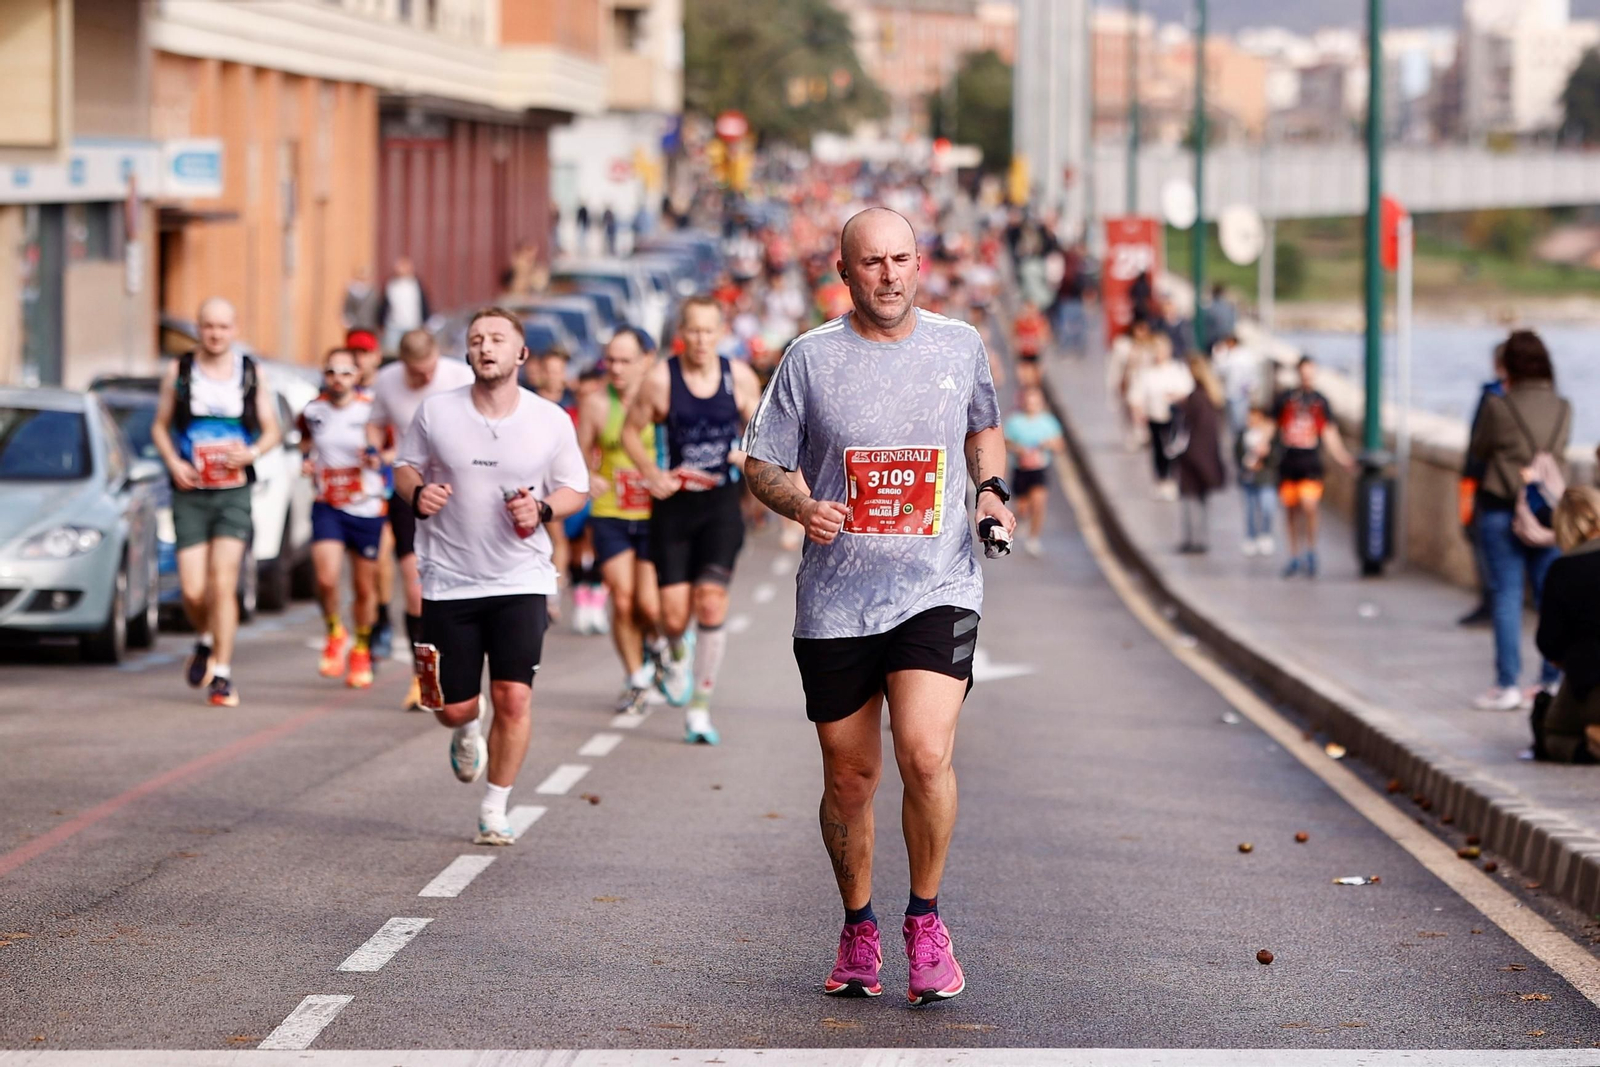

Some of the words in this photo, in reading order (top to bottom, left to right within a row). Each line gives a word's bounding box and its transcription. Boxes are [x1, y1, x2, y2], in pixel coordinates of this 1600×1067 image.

[871, 450, 932, 463] GENERALI
[867, 469, 915, 487] 3109
[869, 508, 892, 517] MÁLAGA
